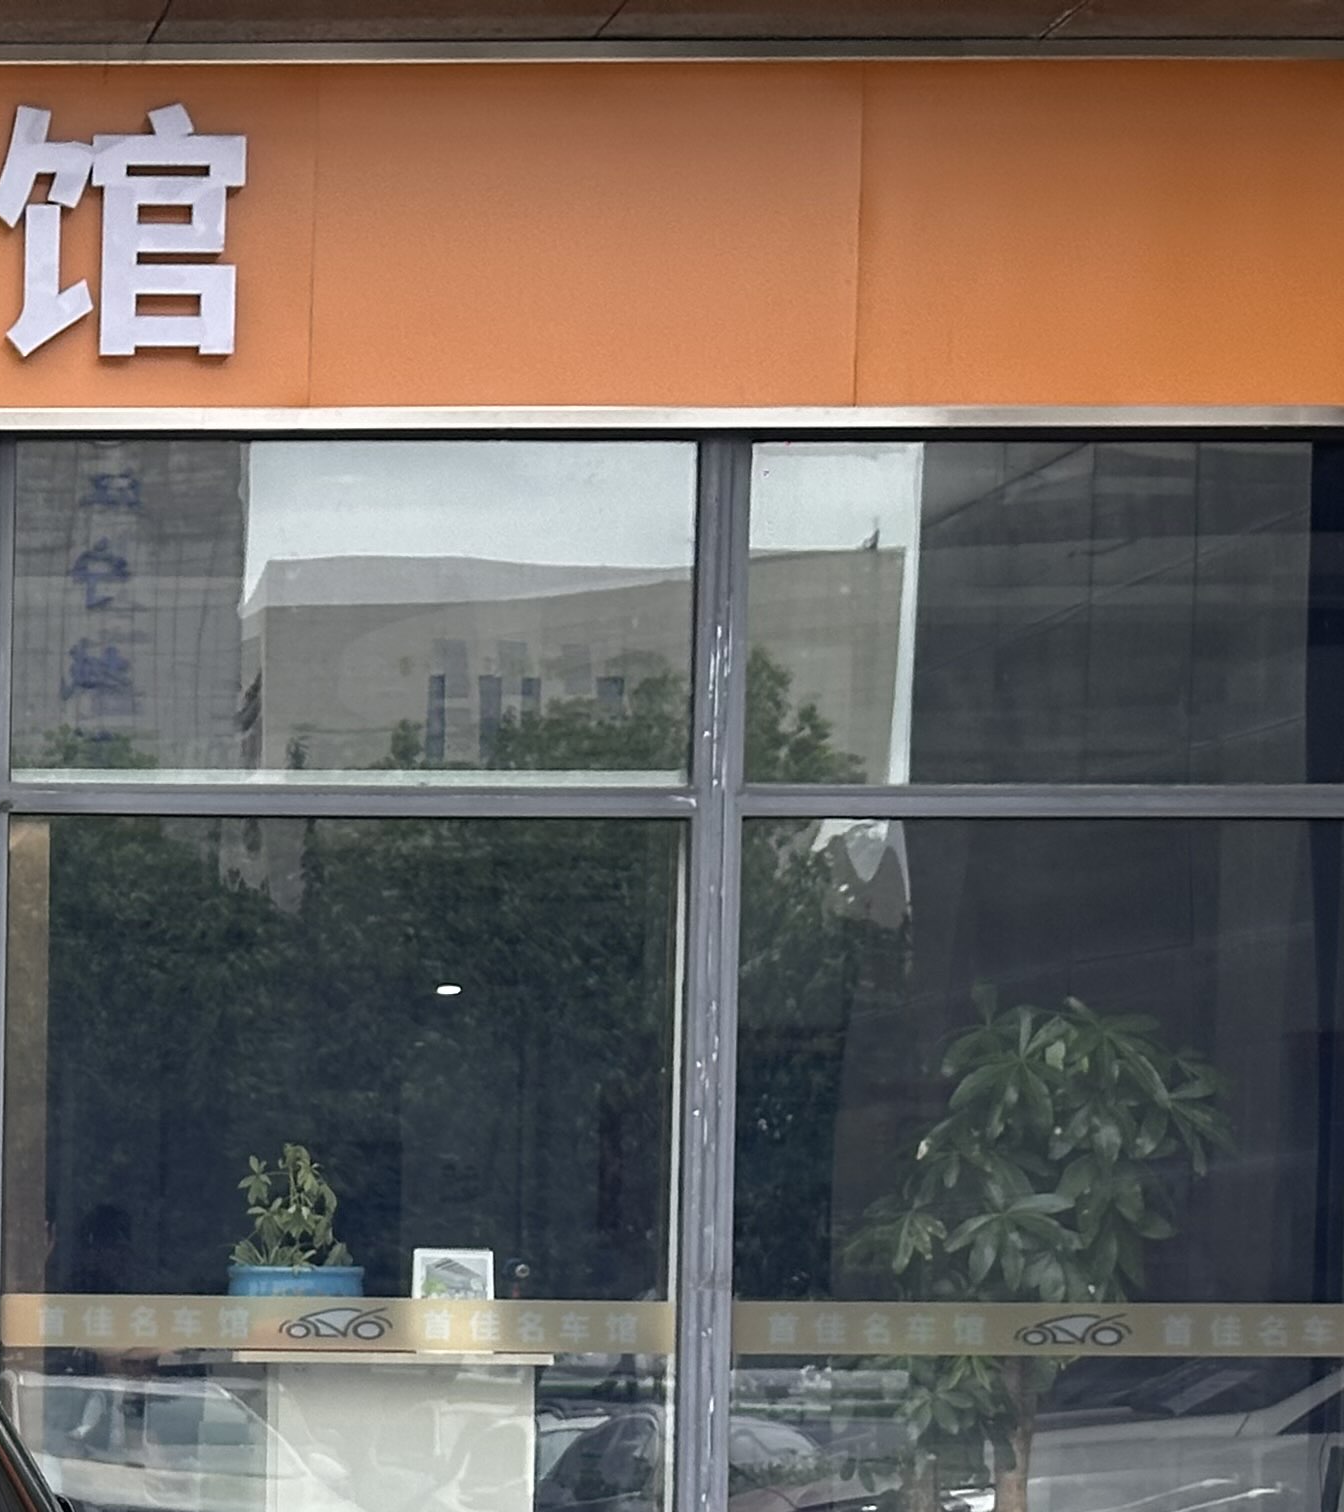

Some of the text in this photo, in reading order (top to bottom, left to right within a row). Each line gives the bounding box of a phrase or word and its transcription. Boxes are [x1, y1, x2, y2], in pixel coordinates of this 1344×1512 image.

[424, 1309, 638, 1342] 首佳名车馆
[768, 1312, 986, 1345] 首佳名车馆
